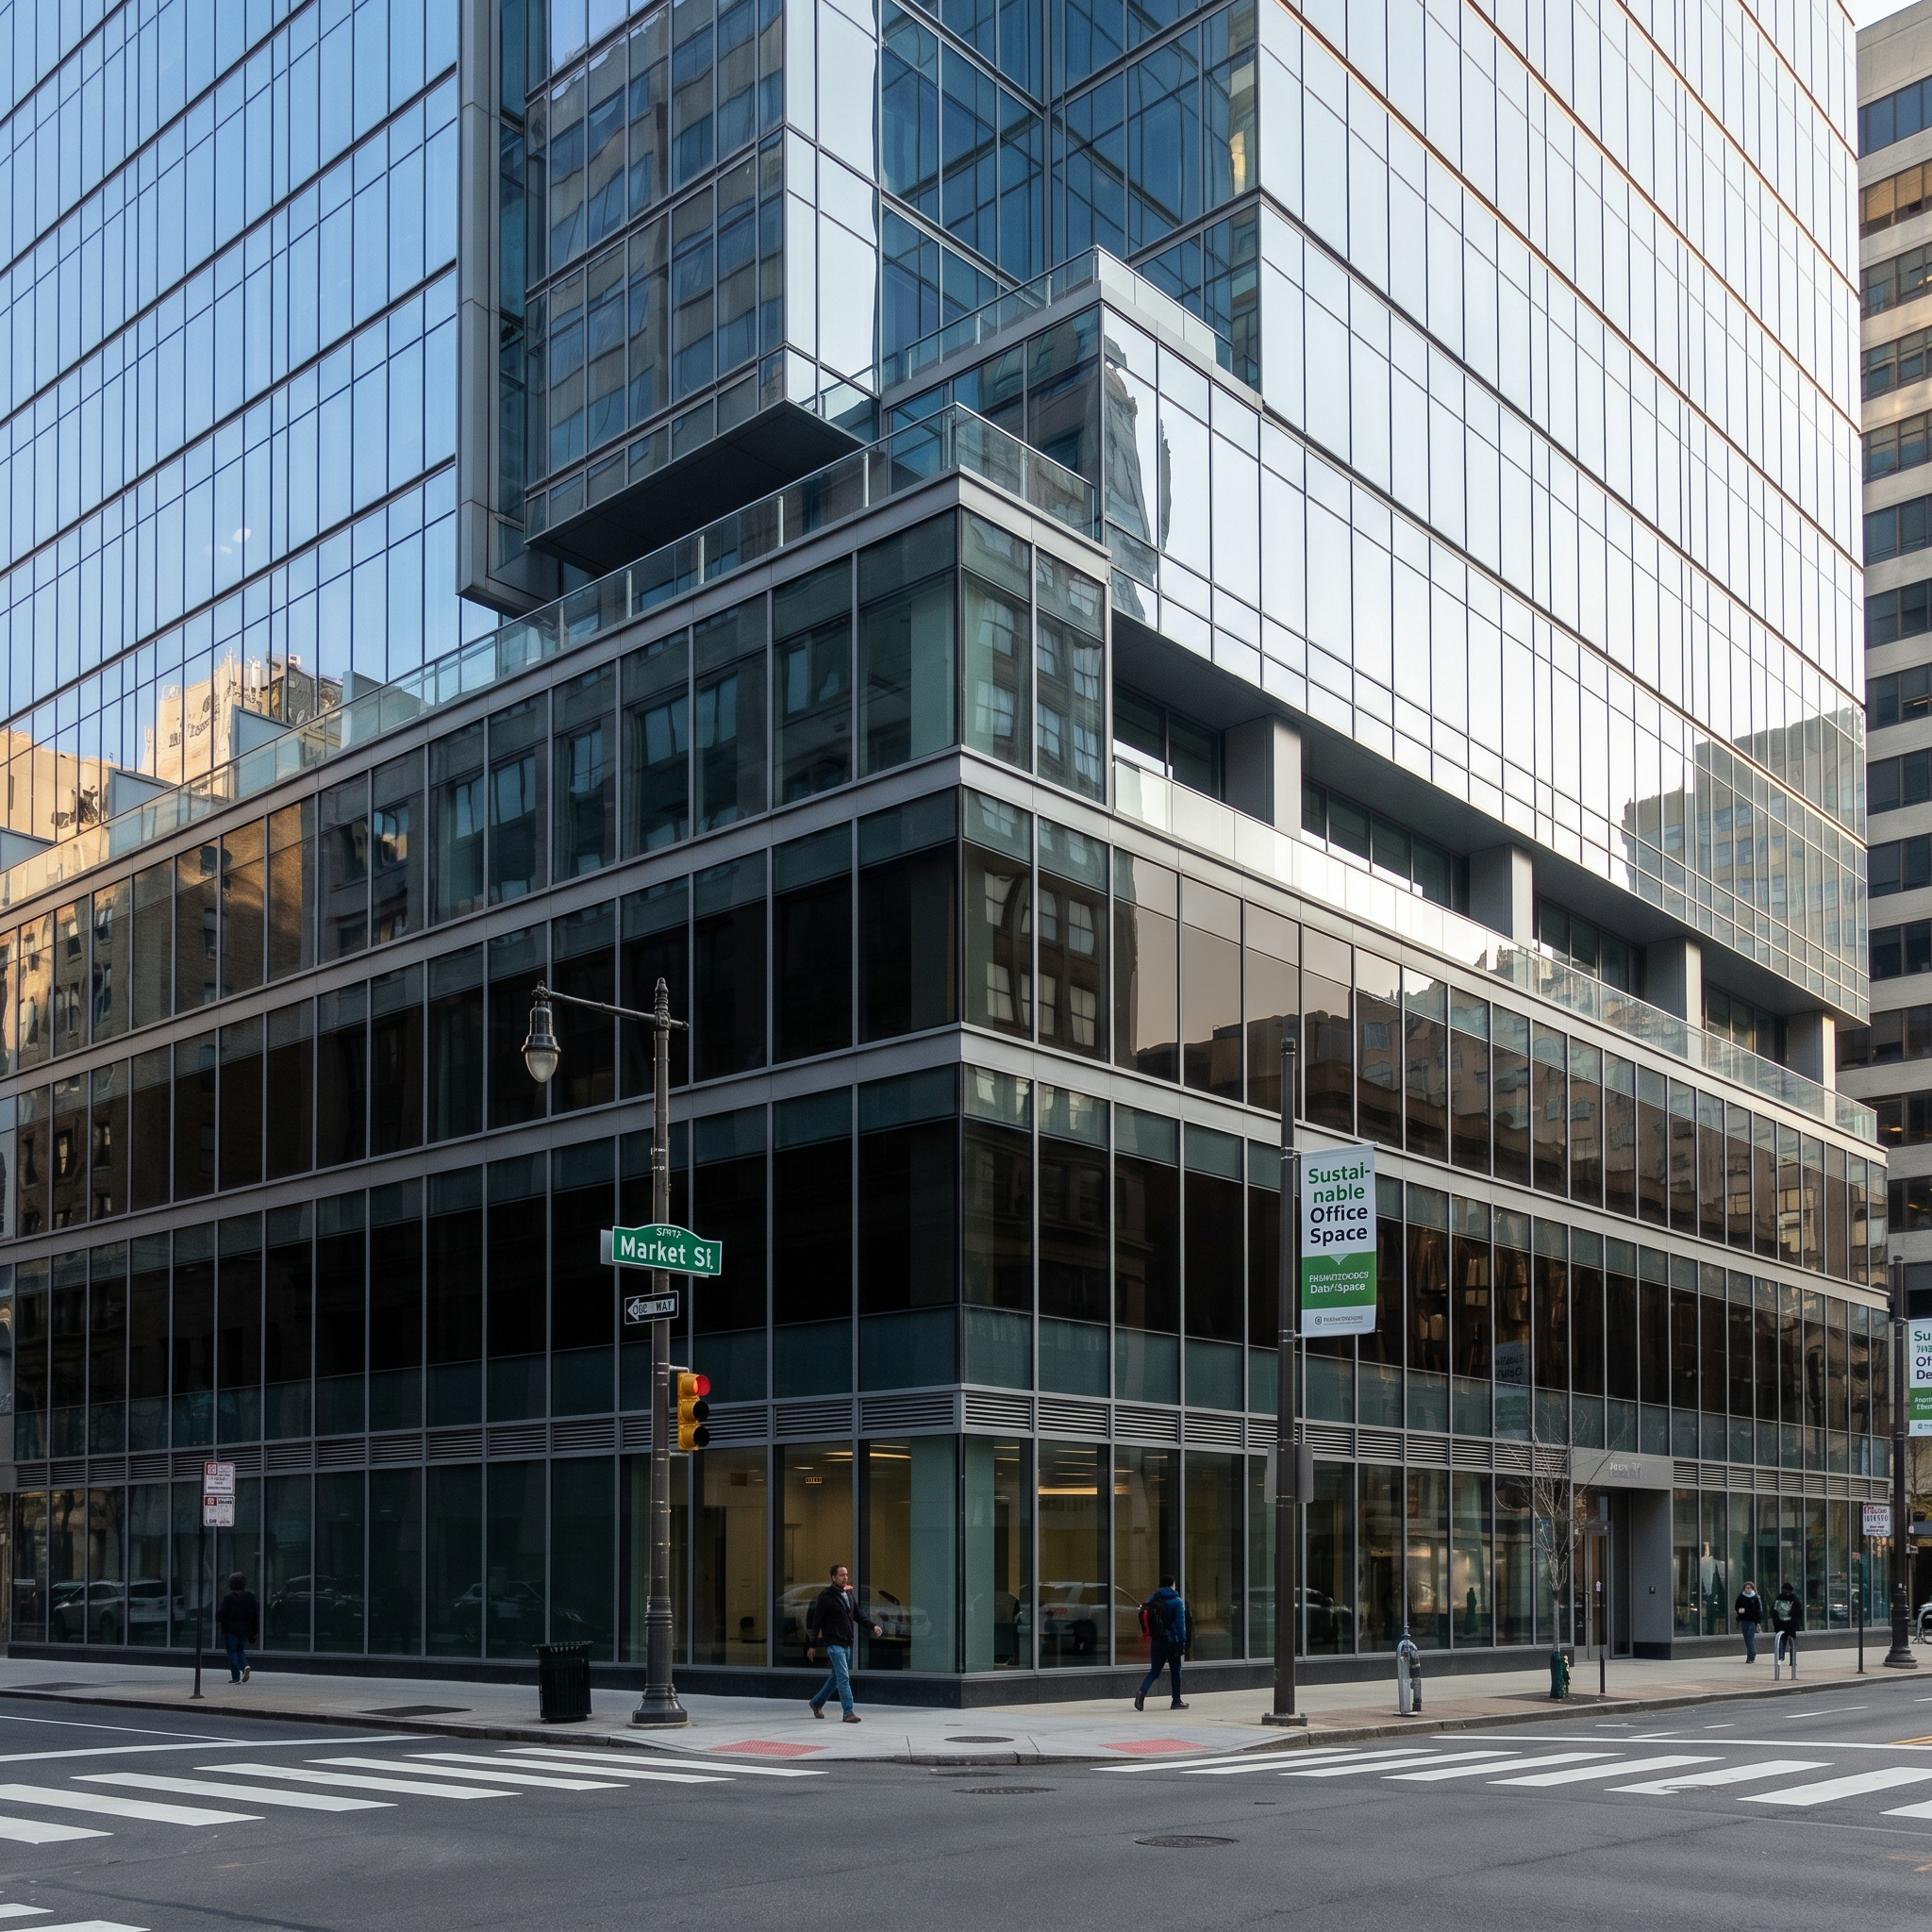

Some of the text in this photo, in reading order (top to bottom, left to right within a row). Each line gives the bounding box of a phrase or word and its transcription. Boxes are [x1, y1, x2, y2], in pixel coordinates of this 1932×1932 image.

[1308, 1161, 1371, 1184] Sustai-
[1313, 1183, 1365, 1204] nable
[1310, 1205, 1368, 1224] Office
[1309, 1227, 1368, 1246] Space
[621, 1235, 686, 1265] Market
